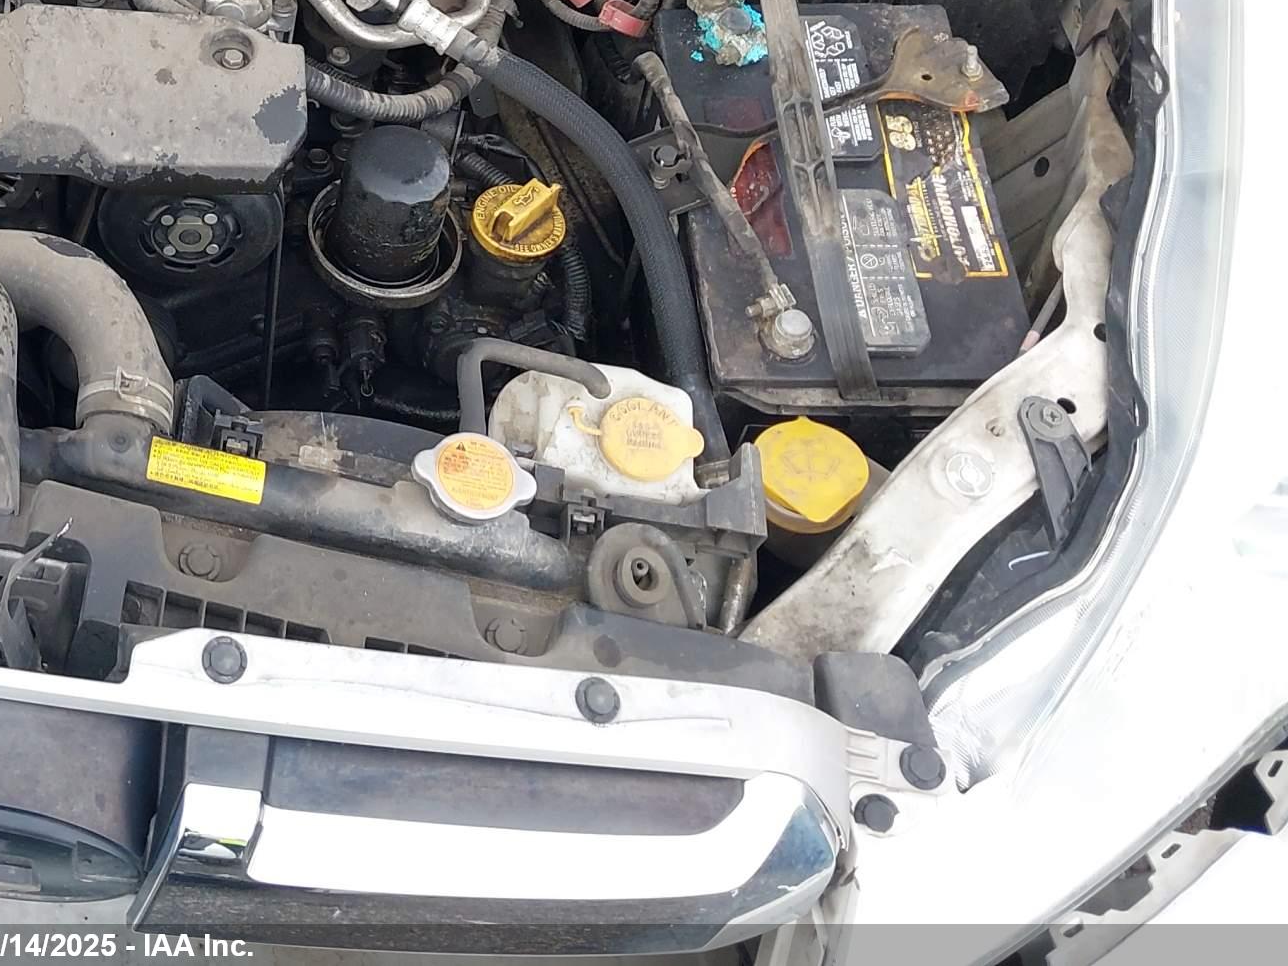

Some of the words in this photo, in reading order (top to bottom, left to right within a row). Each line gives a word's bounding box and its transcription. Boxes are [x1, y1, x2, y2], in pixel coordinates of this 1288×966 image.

[885, 115, 917, 151] 85
[476, 189, 498, 220] ENGINE
[932, 174, 970, 266] AUTOMOTIVE
